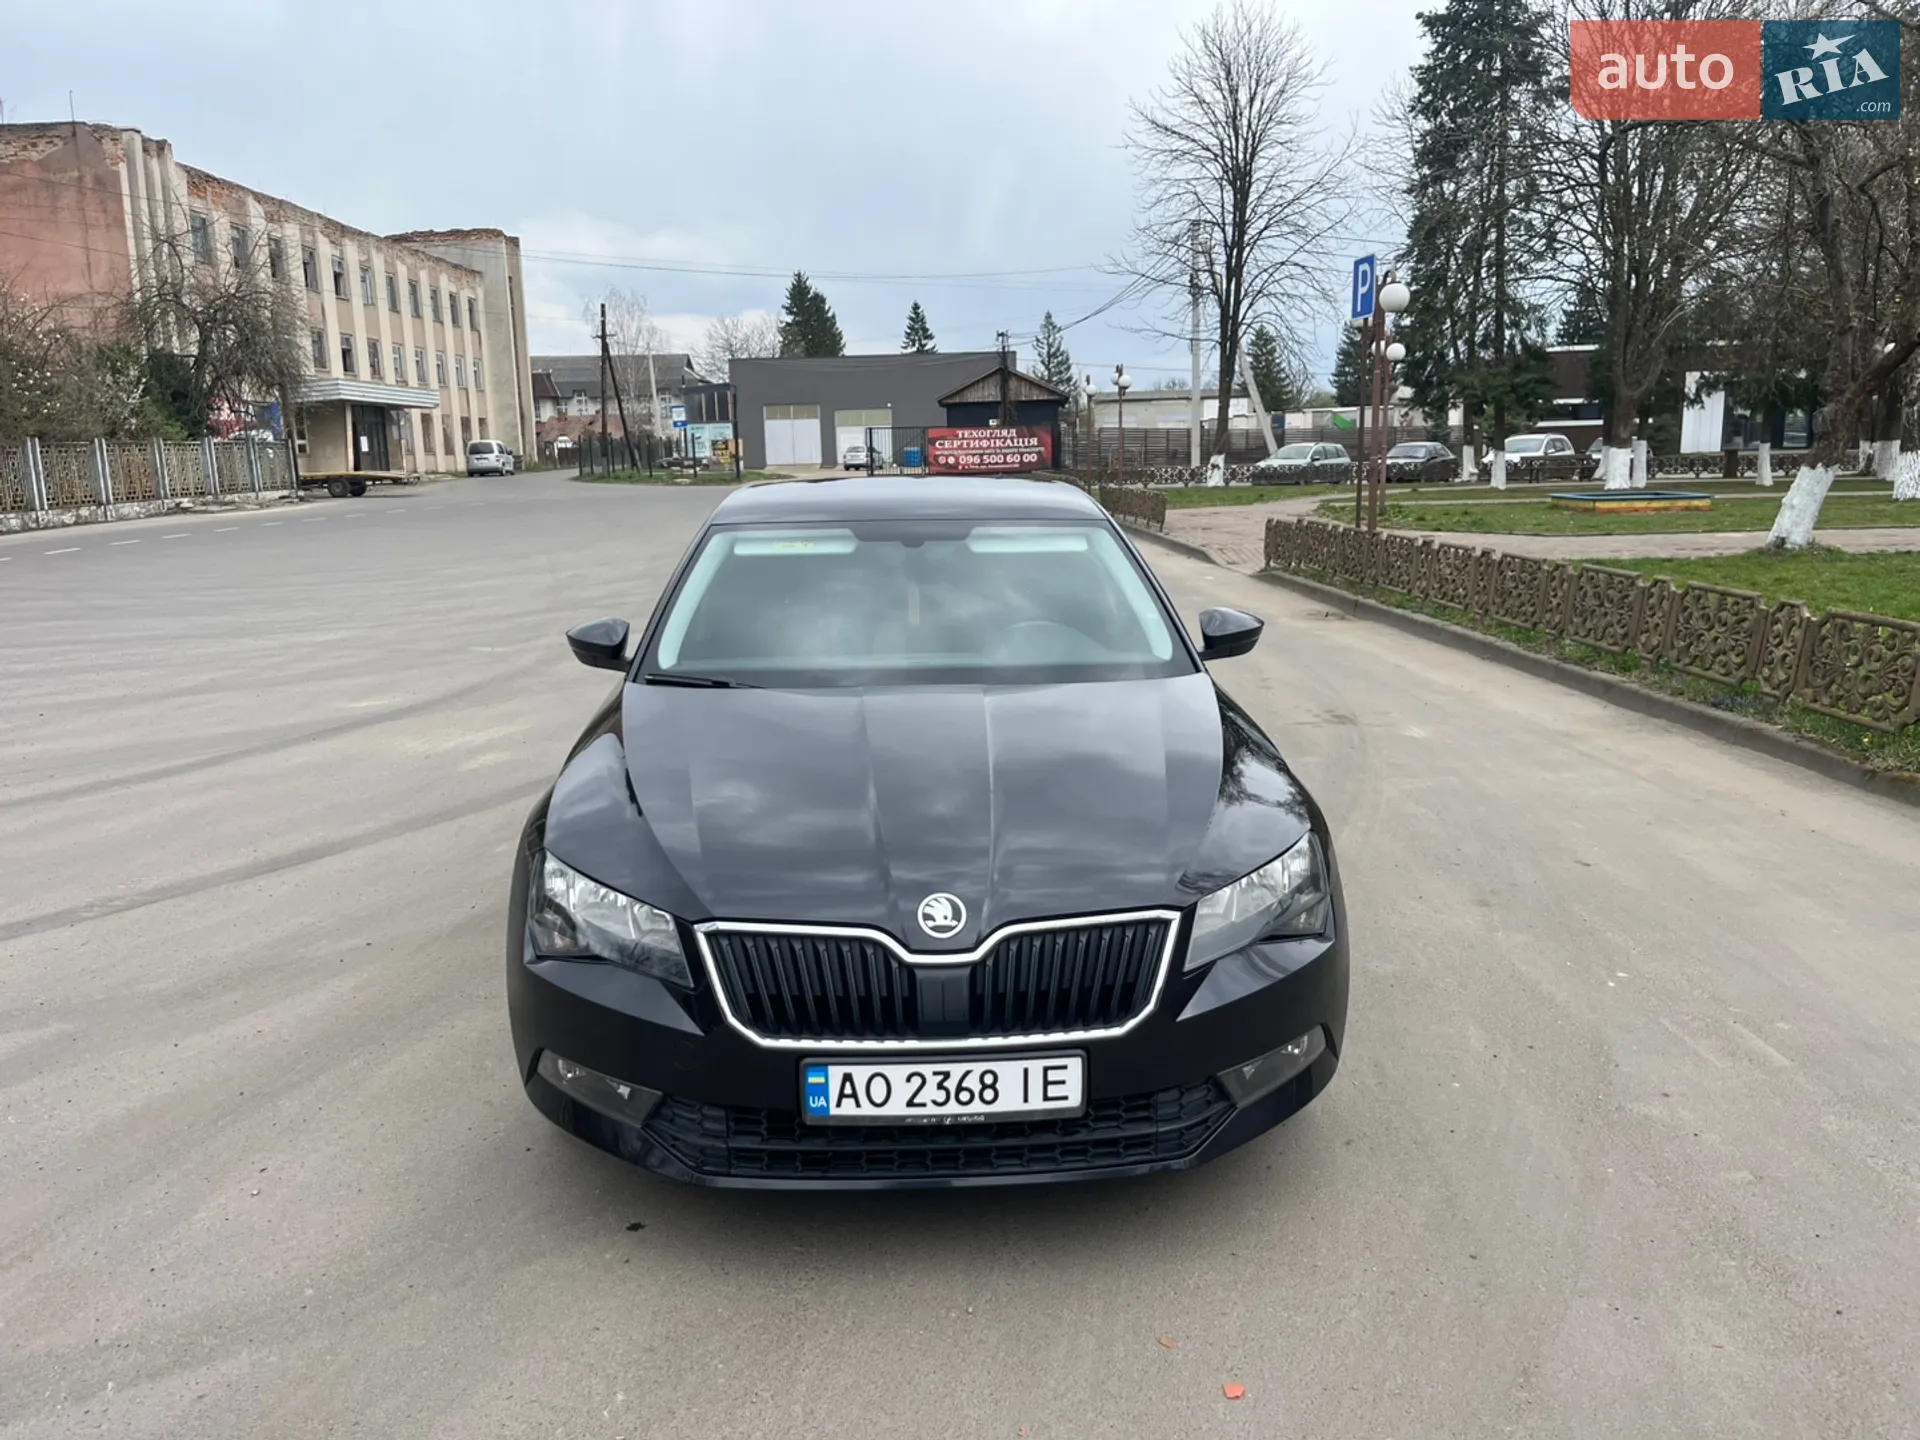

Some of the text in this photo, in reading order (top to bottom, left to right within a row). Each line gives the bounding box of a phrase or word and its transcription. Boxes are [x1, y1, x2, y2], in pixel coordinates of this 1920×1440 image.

[1357, 263, 1371, 312] P
[956, 428, 1017, 439] ТЕХОГЛЯД
[935, 437, 1038, 448] СЕРТИФІКАЦІЯ
[959, 453, 1038, 464] 096 500 60 00
[835, 1064, 1069, 1109] AO 2368 IE
[809, 1096, 827, 1107] UA
